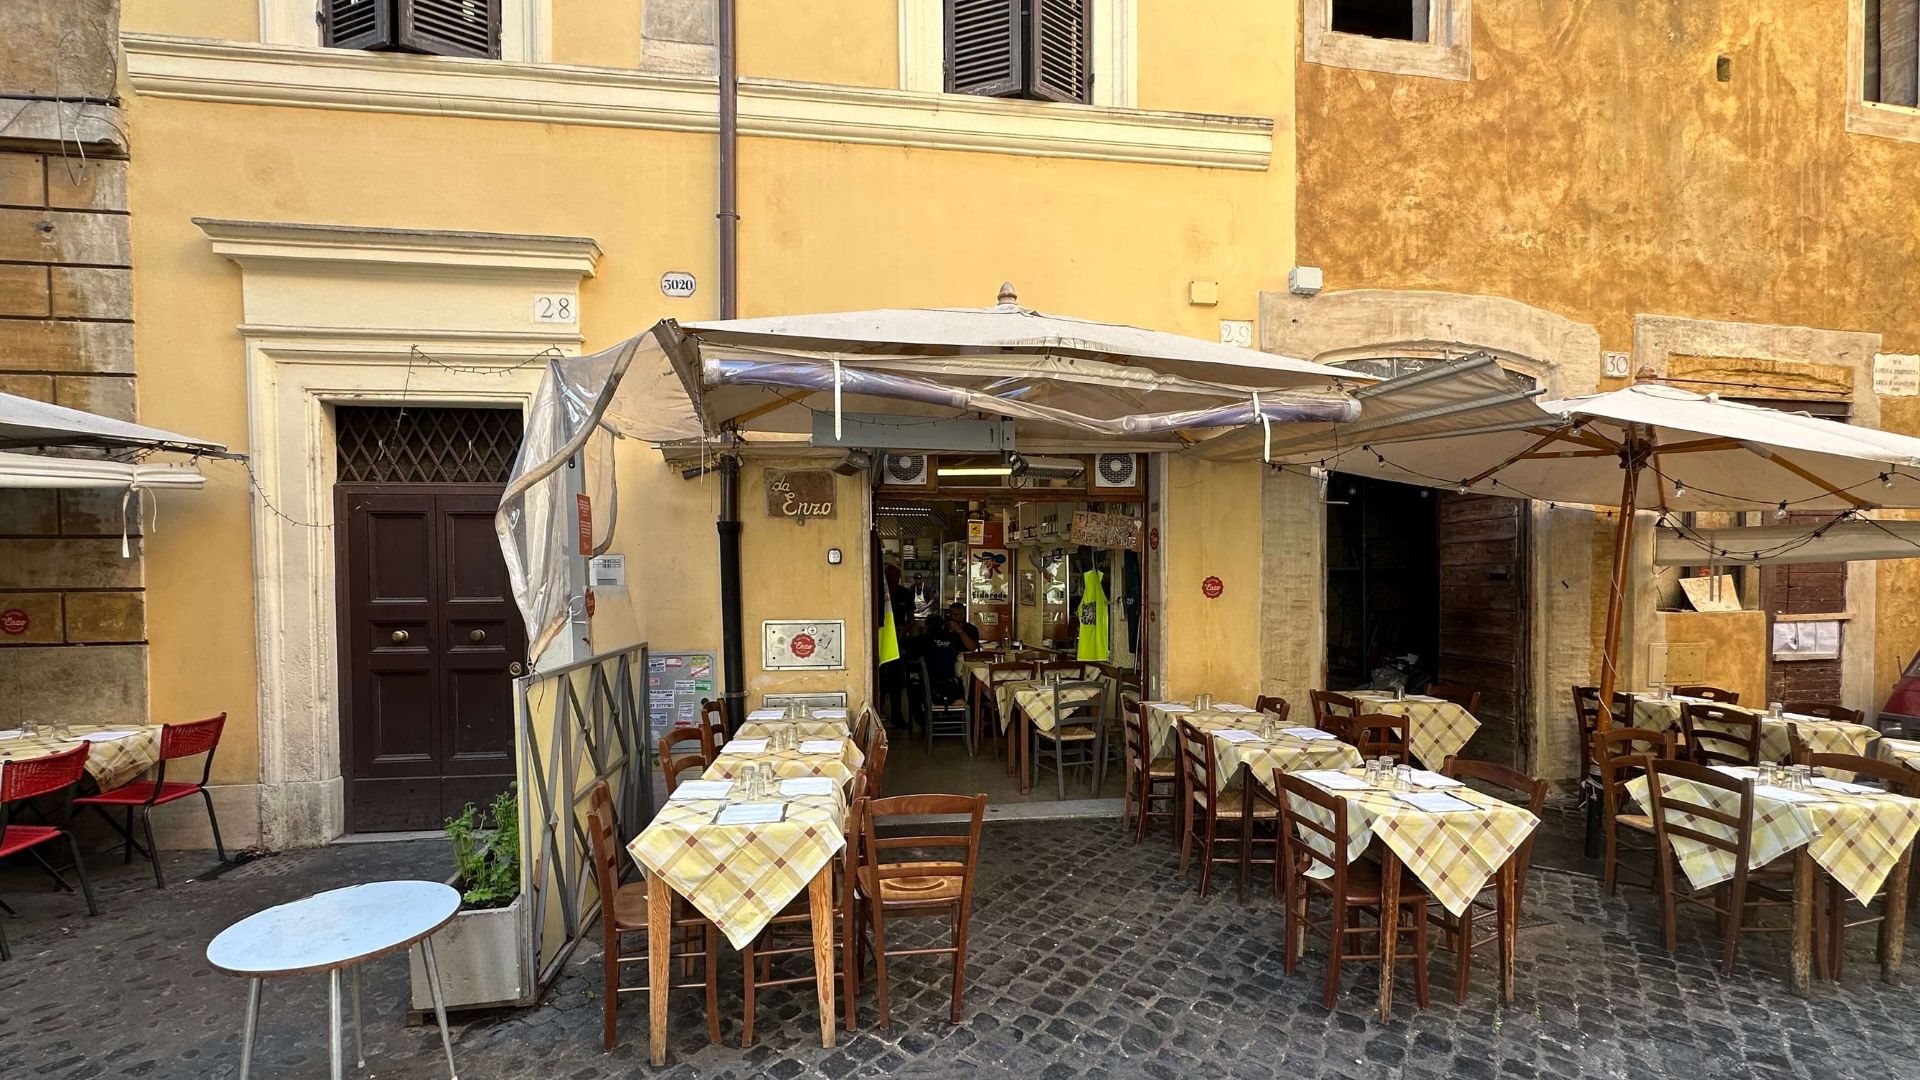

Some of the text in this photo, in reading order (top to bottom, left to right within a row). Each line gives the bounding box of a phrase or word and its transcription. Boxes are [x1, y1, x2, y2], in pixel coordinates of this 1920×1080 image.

[664, 279, 694, 291] 3020
[539, 296, 571, 319] 28
[1222, 323, 1249, 343] 29
[1607, 355, 1628, 373] 30
[771, 474, 790, 491] da
[782, 492, 832, 516] Enzo
[972, 591, 1007, 599] Eldorado
[795, 641, 813, 650] Enzo
